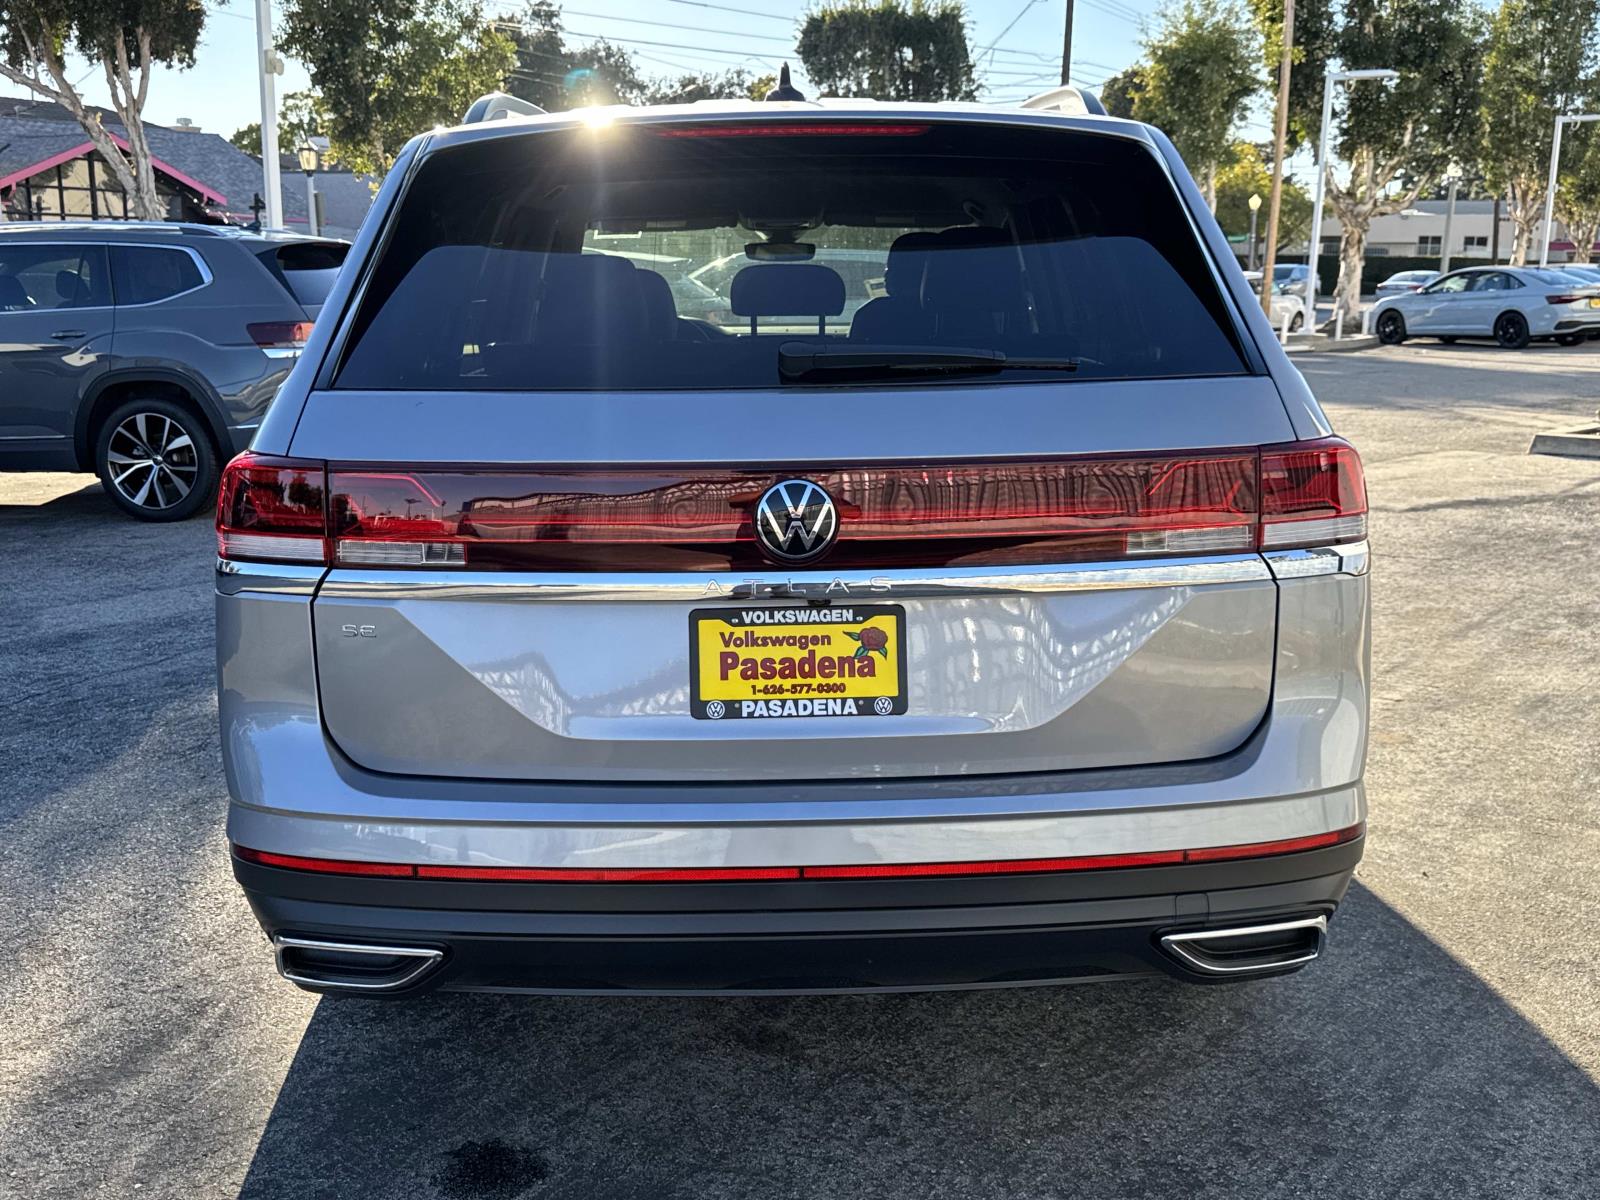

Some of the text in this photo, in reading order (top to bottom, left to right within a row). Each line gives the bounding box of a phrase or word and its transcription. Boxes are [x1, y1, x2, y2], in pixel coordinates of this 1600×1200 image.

[702, 576, 892, 596] ATLAS
[742, 609, 854, 623] VOLKSWAGEN
[342, 624, 377, 638] SE
[719, 631, 832, 649] Volkswagen
[719, 650, 877, 681] Pasadena
[750, 683, 847, 695] 1-626-577-0300
[741, 698, 858, 718] PASADENA
